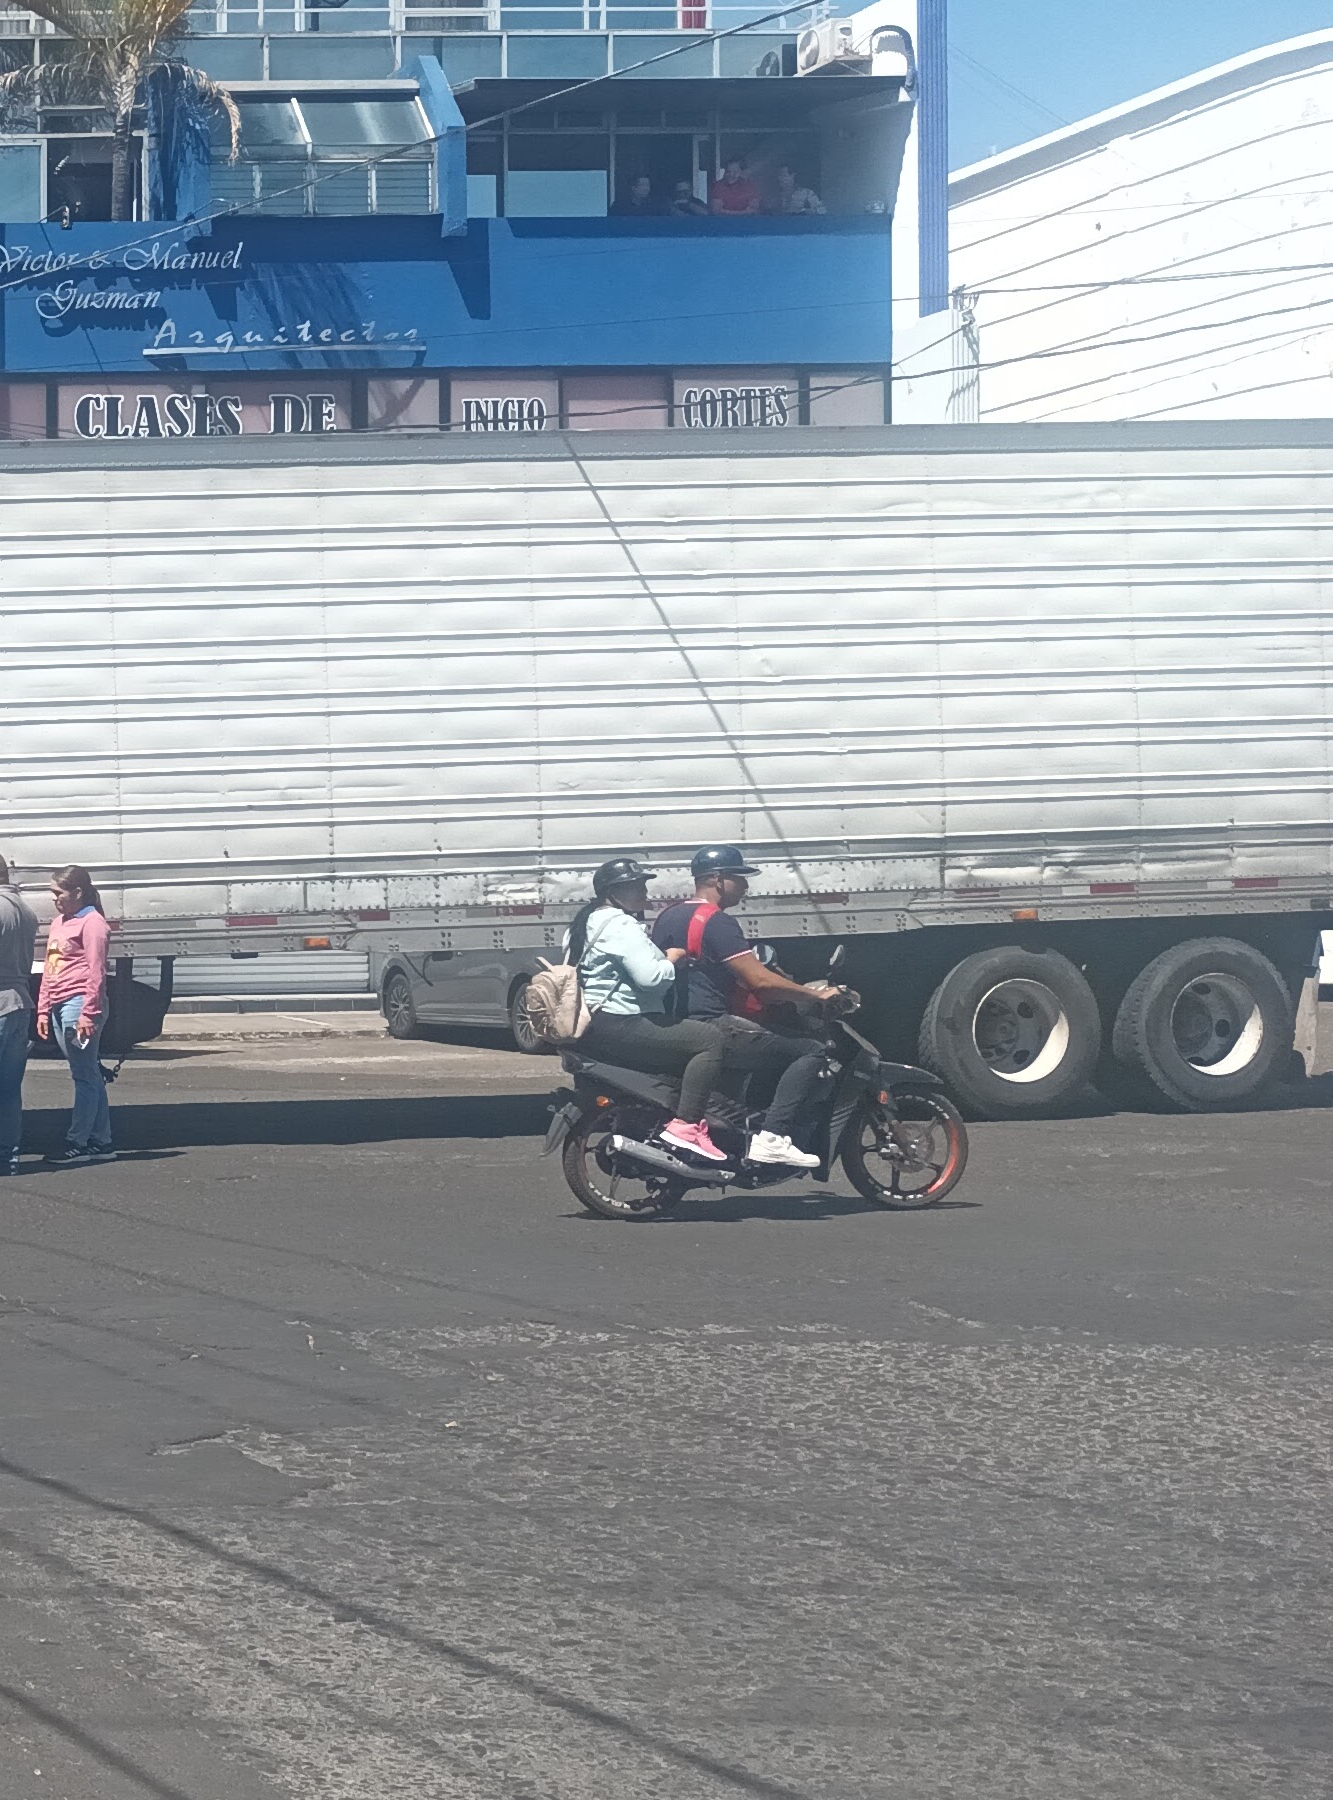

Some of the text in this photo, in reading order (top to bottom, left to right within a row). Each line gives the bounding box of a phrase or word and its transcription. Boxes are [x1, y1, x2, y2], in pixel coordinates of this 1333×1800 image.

[88, 250, 111, 270] &
[123, 241, 244, 271] Manuel
[35, 279, 162, 319] Guzman
[153, 318, 419, 354] Arquitectos
[74, 393, 337, 438] CLASES DE
[461, 397, 547, 432] INICIO
[681, 385, 789, 429] CORTES
